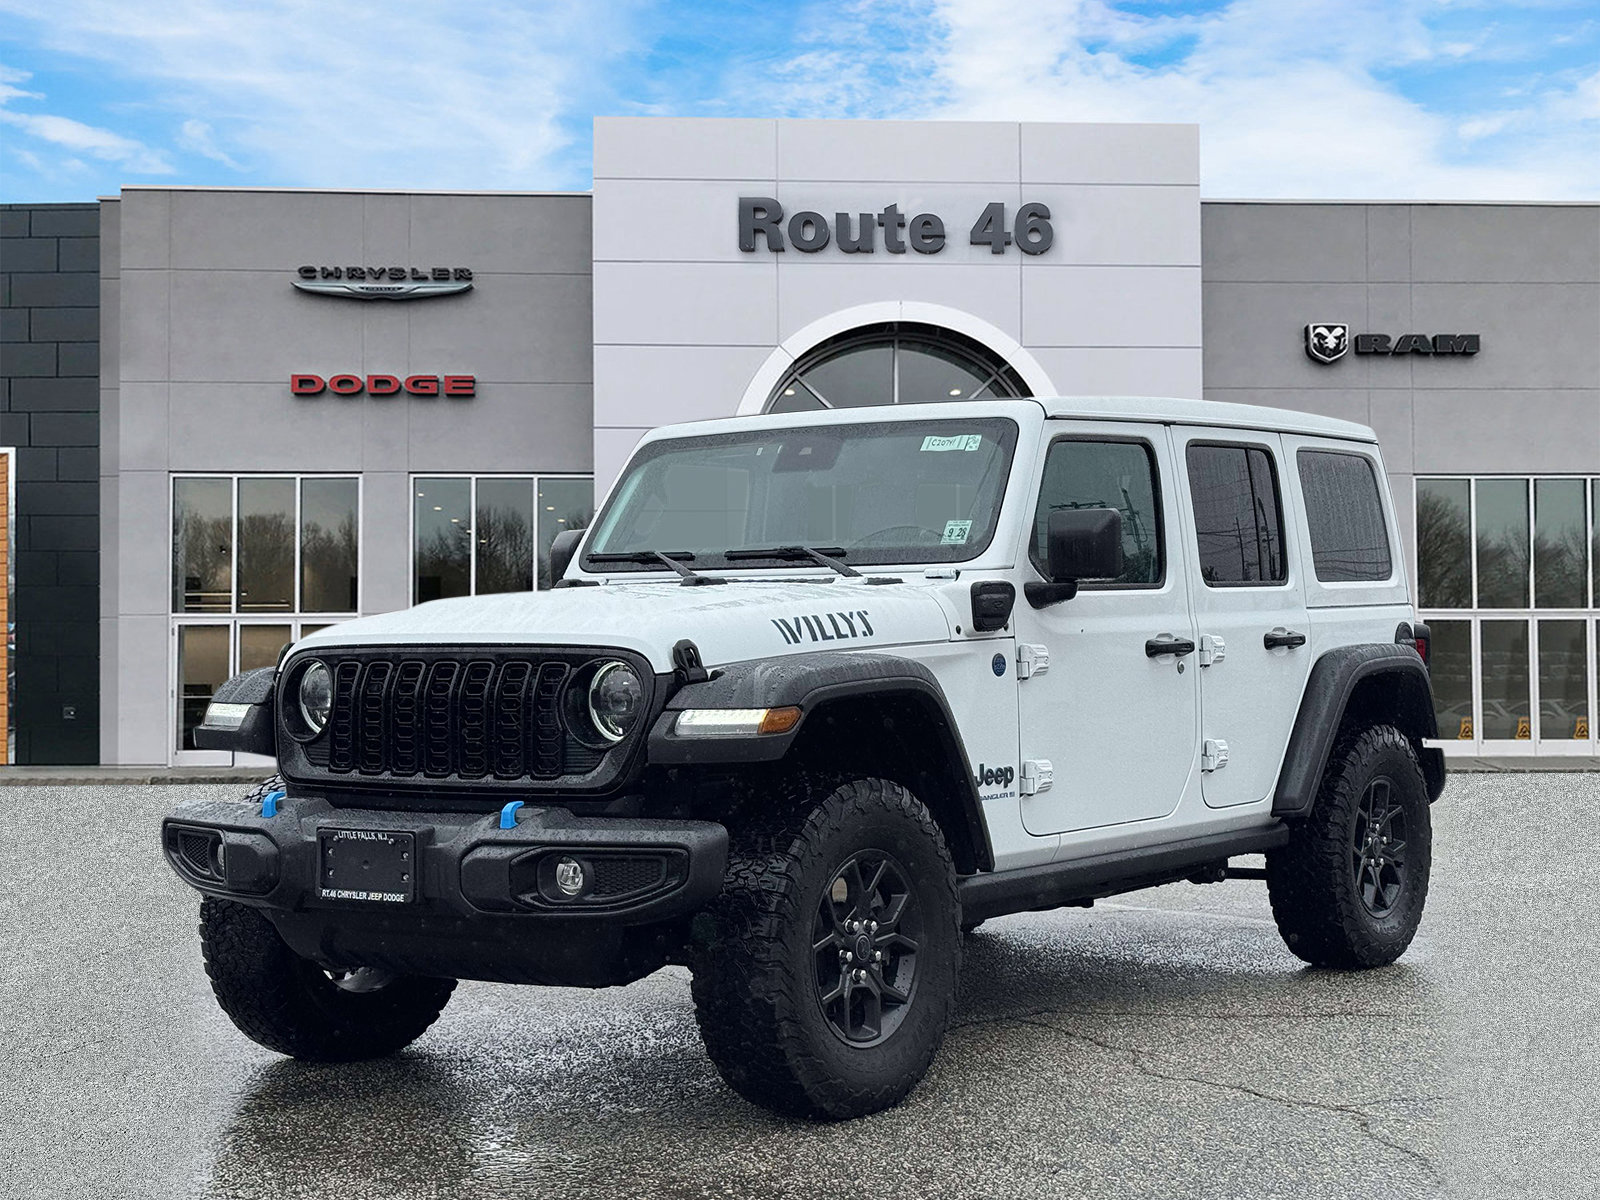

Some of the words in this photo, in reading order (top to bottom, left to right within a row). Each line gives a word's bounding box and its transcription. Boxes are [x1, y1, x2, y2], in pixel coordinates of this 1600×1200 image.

[738, 197, 946, 253] Route
[970, 202, 1054, 255] 46
[298, 266, 473, 280] CHRYSLER
[1354, 334, 1480, 356] RAM
[290, 374, 476, 397] DODGE
[771, 610, 874, 644] WILLYS
[976, 763, 1014, 788] Jeep
[337, 831, 357, 840] LITTLE
[357, 831, 378, 841] FALLS,
[337, 890, 367, 900] CHRYSLER
[368, 892, 383, 901] JEEP
[383, 893, 405, 902] DODGE
